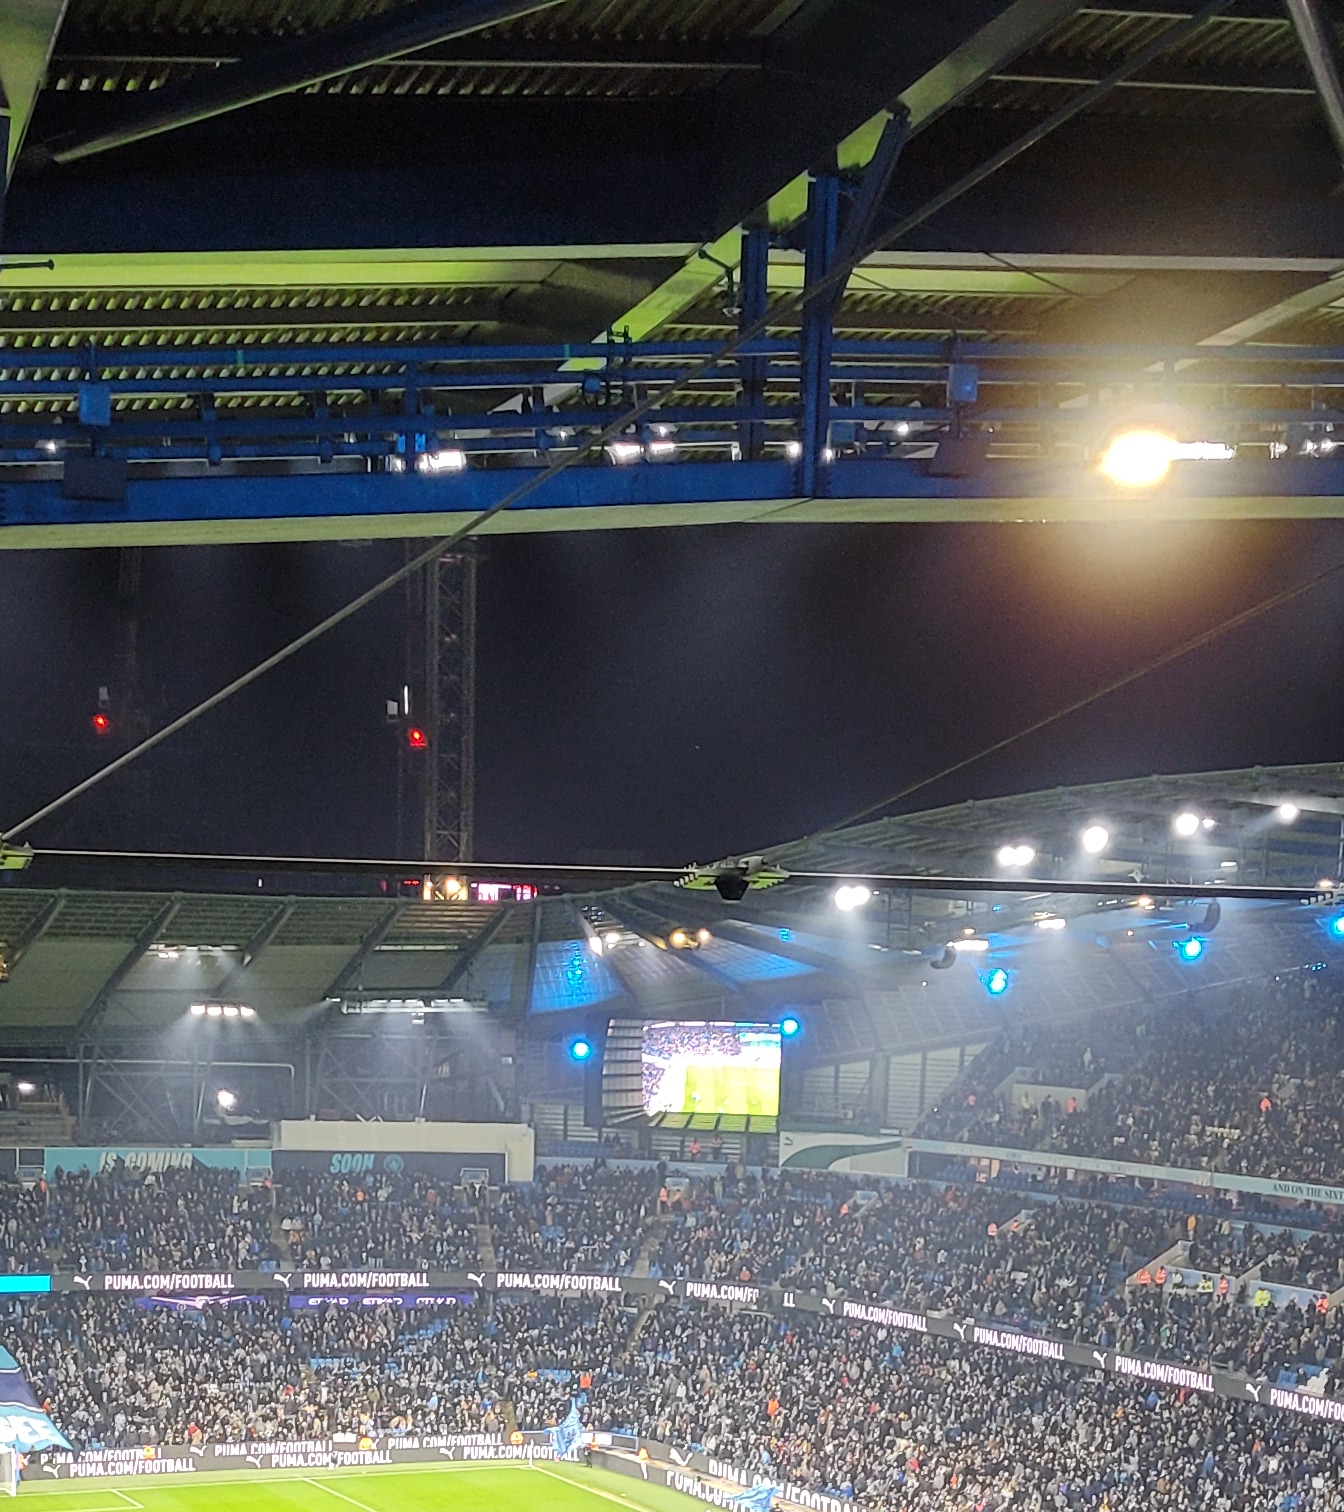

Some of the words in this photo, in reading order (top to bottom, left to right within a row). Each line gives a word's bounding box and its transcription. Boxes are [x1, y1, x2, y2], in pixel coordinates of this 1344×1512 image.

[330, 1153, 375, 1174] SOON
[104, 1272, 235, 1291] PUMA.COM/FOOTBALL
[303, 1272, 430, 1289] PUMA.COM/FOOTBALL
[496, 1272, 622, 1292] PUMA.COM/FOOTBALL
[843, 1301, 928, 1333] PUMA.COM/FOOTBALL
[973, 1326, 1066, 1361] PUMA.COM/FOOTBALL
[1114, 1353, 1216, 1394] PUMA.COM/FOOTBALL
[69, 1458, 197, 1478] PUMA.COM/FOOTBALL
[270, 1449, 393, 1469] PUMA.COMFOOTBALL
